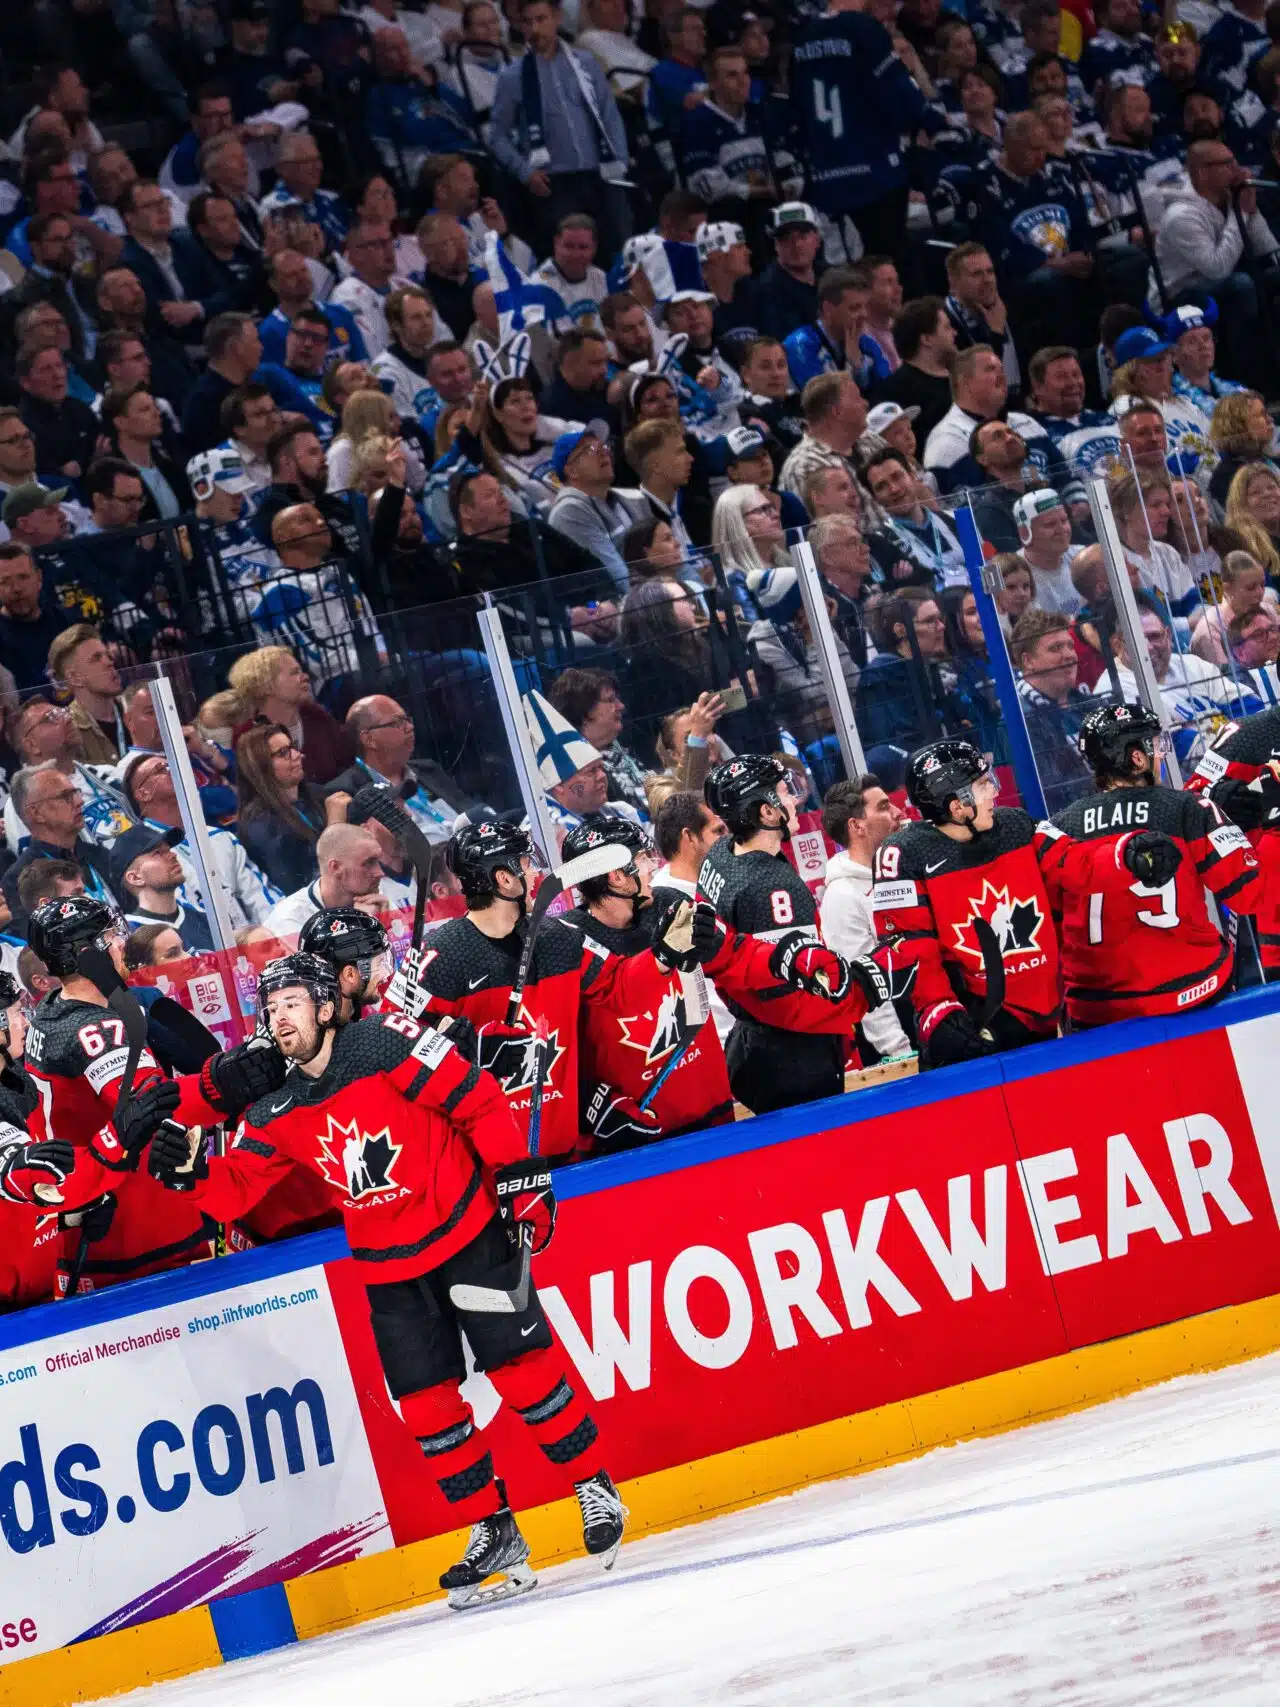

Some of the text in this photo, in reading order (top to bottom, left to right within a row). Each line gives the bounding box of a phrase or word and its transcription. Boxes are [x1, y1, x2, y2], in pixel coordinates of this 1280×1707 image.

[813, 78, 845, 139] 4
[1084, 801, 1151, 835] BLAIS
[798, 838, 819, 853] BIO
[873, 846, 901, 879] 19
[698, 858, 726, 905] GLASS
[770, 888, 794, 926] 8
[195, 980, 218, 996] BIO
[856, 955, 889, 1000] BAUE
[1187, 979, 1216, 1002] IIHF
[78, 1018, 124, 1058] 67
[496, 1172, 553, 1196] BAUER
[538, 1112, 1254, 1402] WORKWEAR
[187, 1286, 319, 1334] shop.iihfworlds.com
[45, 1325, 181, 1374] Official Merchandise
